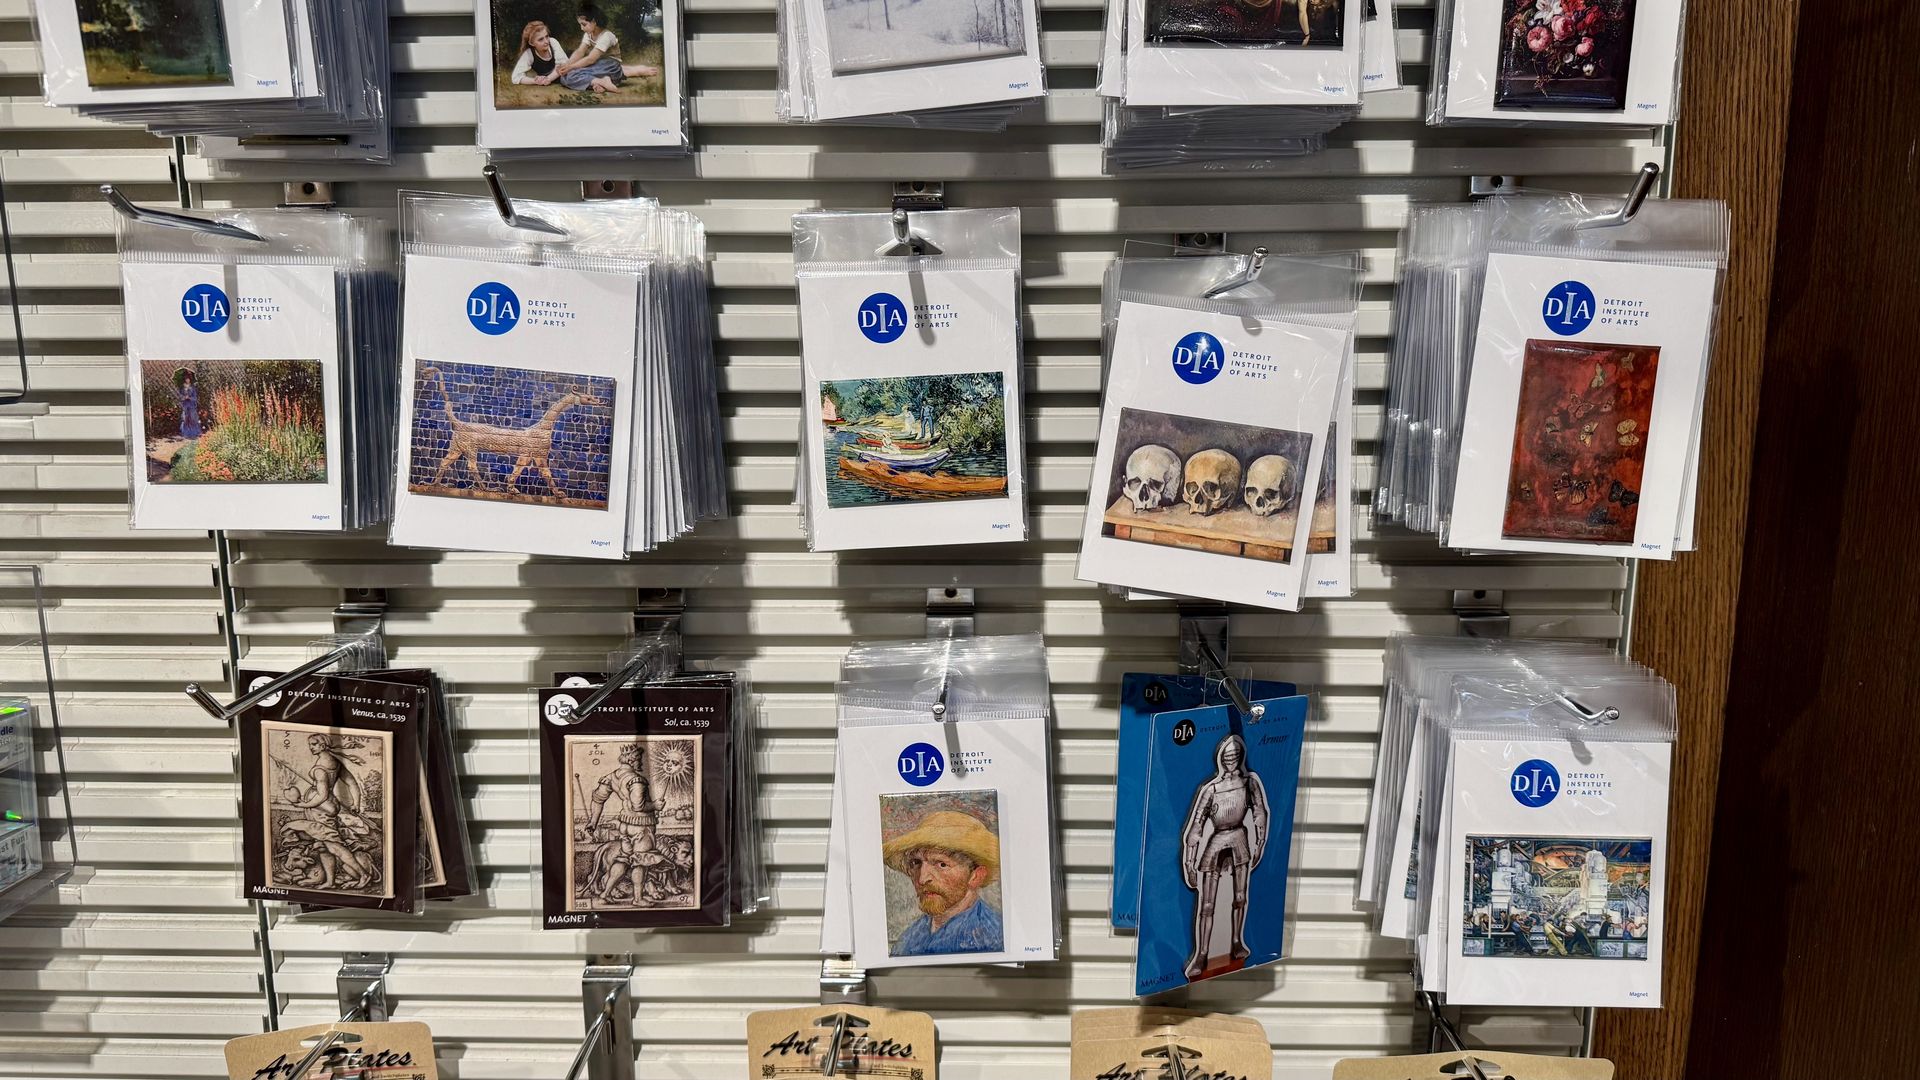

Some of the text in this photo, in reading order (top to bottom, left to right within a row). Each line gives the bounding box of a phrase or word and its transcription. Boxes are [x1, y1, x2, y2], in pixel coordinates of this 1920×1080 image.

[1363, 73, 1383, 81] Magnet
[256, 79, 278, 87] Magnet
[1008, 81, 1029, 89] Magnet
[1323, 85, 1344, 93] Magnet
[527, 299, 568, 309] DETROIT
[1603, 298, 1643, 307] DETROIT
[183, 293, 228, 323] DIA
[469, 292, 517, 325] DIA
[1545, 291, 1591, 325] DIA
[1602, 308, 1649, 318] INSTITUTE
[527, 309, 576, 319] INSTITUTE
[860, 303, 905, 334] DIA
[914, 312, 958, 320] INSTITUTE
[543, 319, 566, 327] ARTS
[1616, 318, 1639, 326] ARTS
[1232, 351, 1271, 361] DETROIT
[1230, 360, 1278, 372] INSTITUTE
[1244, 371, 1267, 380] ARTS
[590, 539, 611, 547] Magnet
[1266, 589, 1287, 598] Magnet
[287, 690, 325, 699] DETROIT
[327, 693, 372, 704] INSTITUTE
[389, 700, 410, 709] ARTS
[351, 708, 376, 719] Venus,
[389, 713, 406, 722] 1539
[663, 717, 679, 727] Sol,
[693, 719, 710, 728] 1539
[950, 751, 985, 759] DETROIT
[900, 751, 942, 778] DIA
[950, 758, 992, 766] INSTITUTE
[1513, 769, 1557, 798] DIA
[548, 914, 588, 924] MAGNET
[1140, 972, 1177, 988] MAGNET
[762, 1030, 819, 1058] Art
